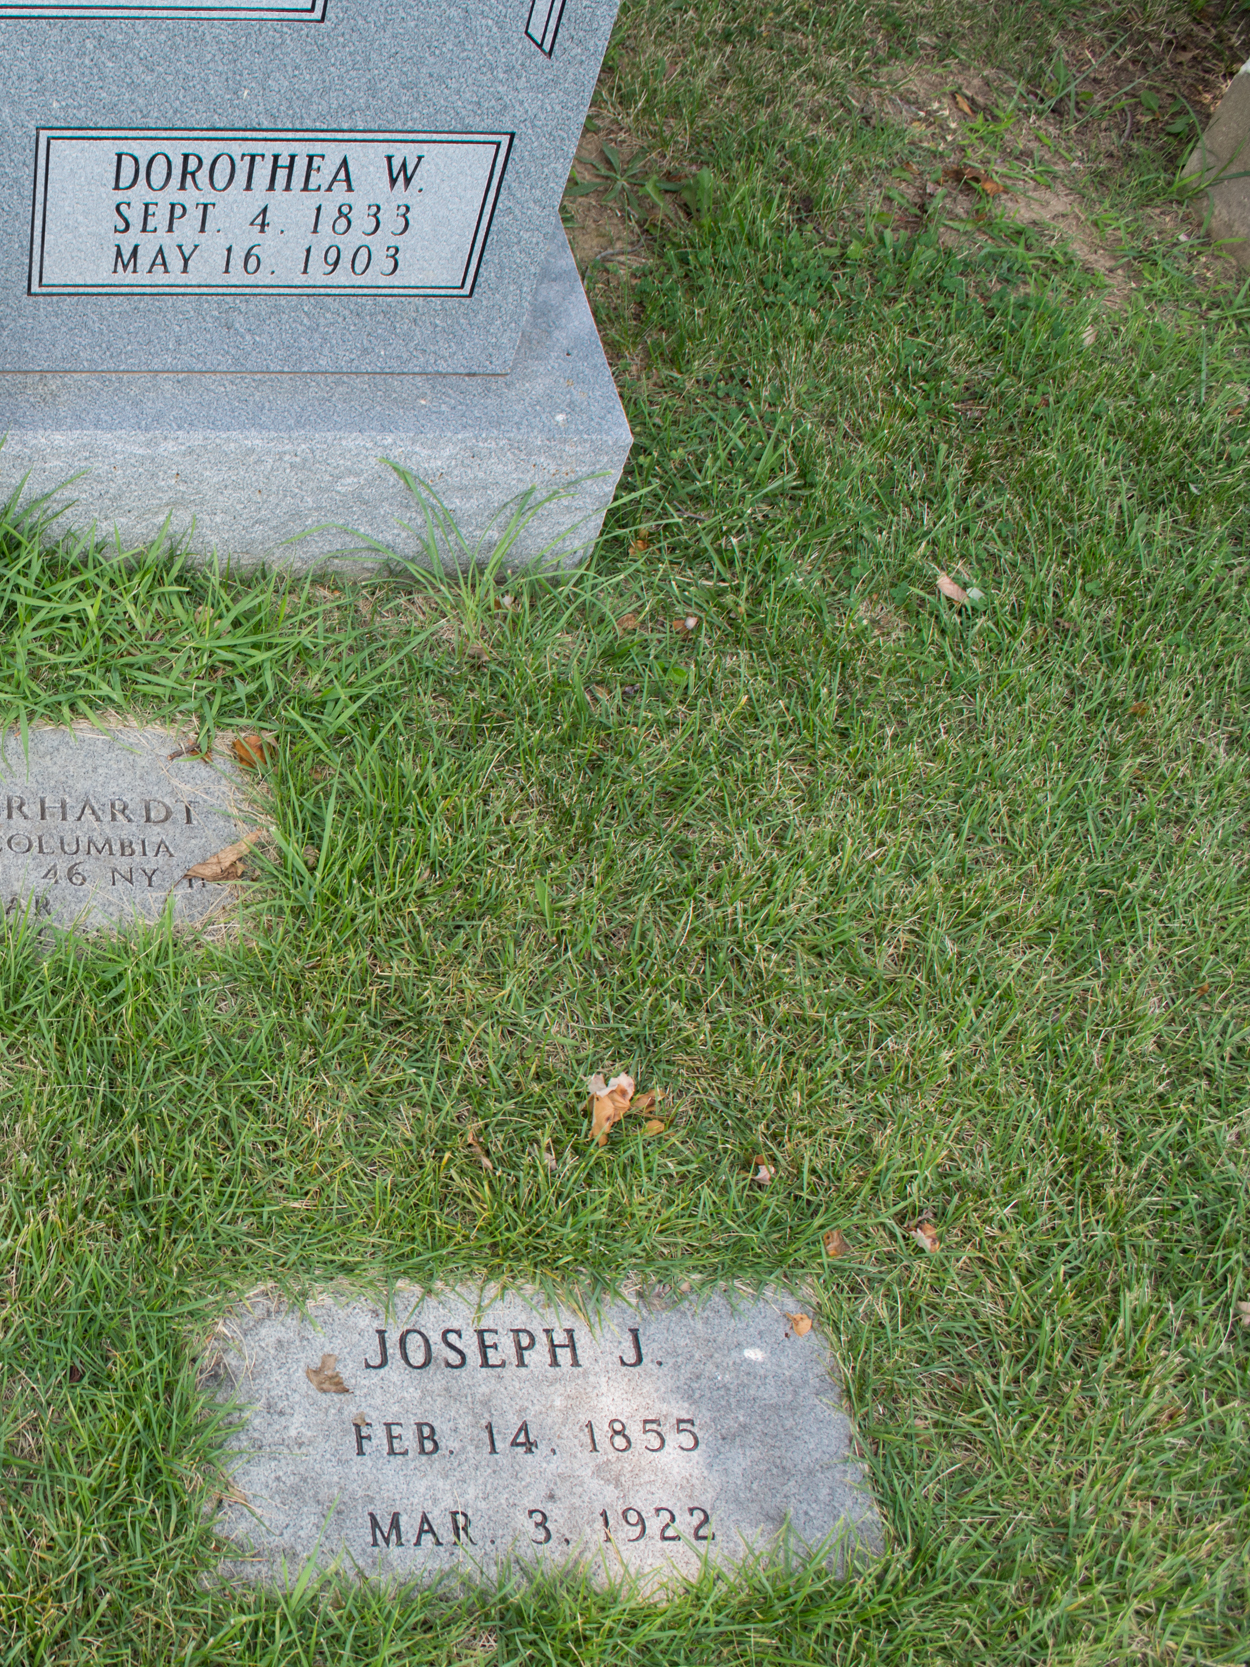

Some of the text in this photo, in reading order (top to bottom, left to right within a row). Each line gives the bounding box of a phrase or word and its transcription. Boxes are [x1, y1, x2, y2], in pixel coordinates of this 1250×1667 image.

[112, 151, 425, 193] DOROTHEA W.
[113, 201, 222, 234] SEPT.
[311, 203, 411, 236] 1833
[112, 244, 200, 275] MAY
[301, 244, 400, 277] 1903
[42, 861, 88, 886] 46
[111, 866, 159, 888] NY
[364, 1328, 663, 1370] JOSEPH J.
[352, 1418, 700, 1457] FEB. 14, 1855
[367, 1507, 716, 1548] MAR. 3, 1922
